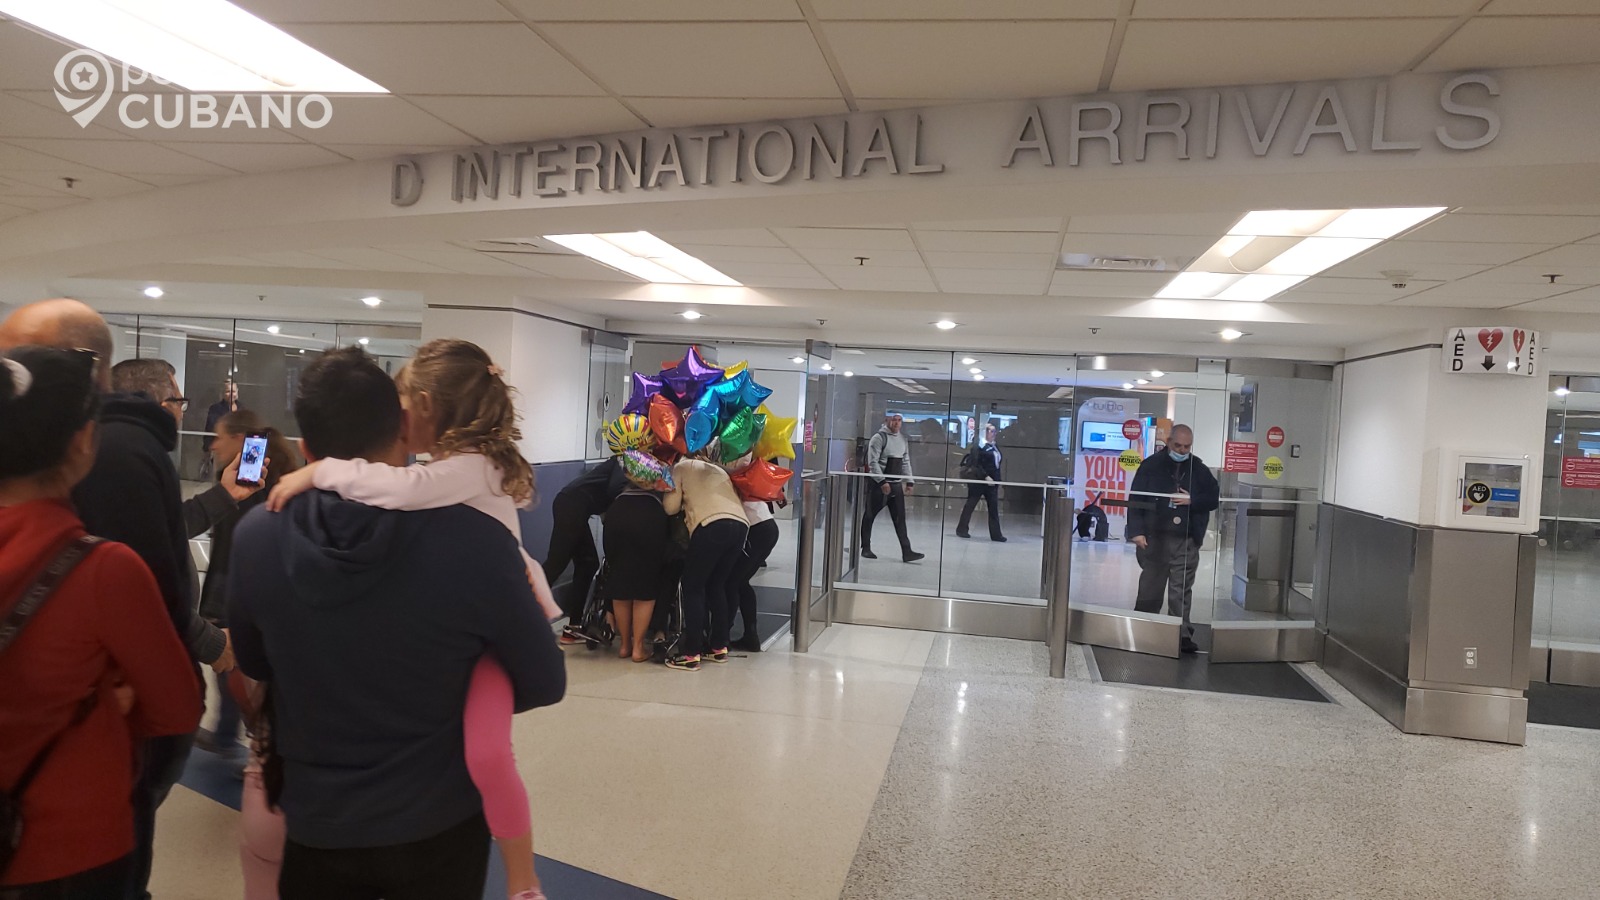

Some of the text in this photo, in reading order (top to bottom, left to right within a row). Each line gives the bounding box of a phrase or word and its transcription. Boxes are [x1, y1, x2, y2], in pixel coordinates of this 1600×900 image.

[390, 73, 1501, 208] D INTERNATIONAL ARRIVALS
[1084, 455, 1127, 481] YOUR
